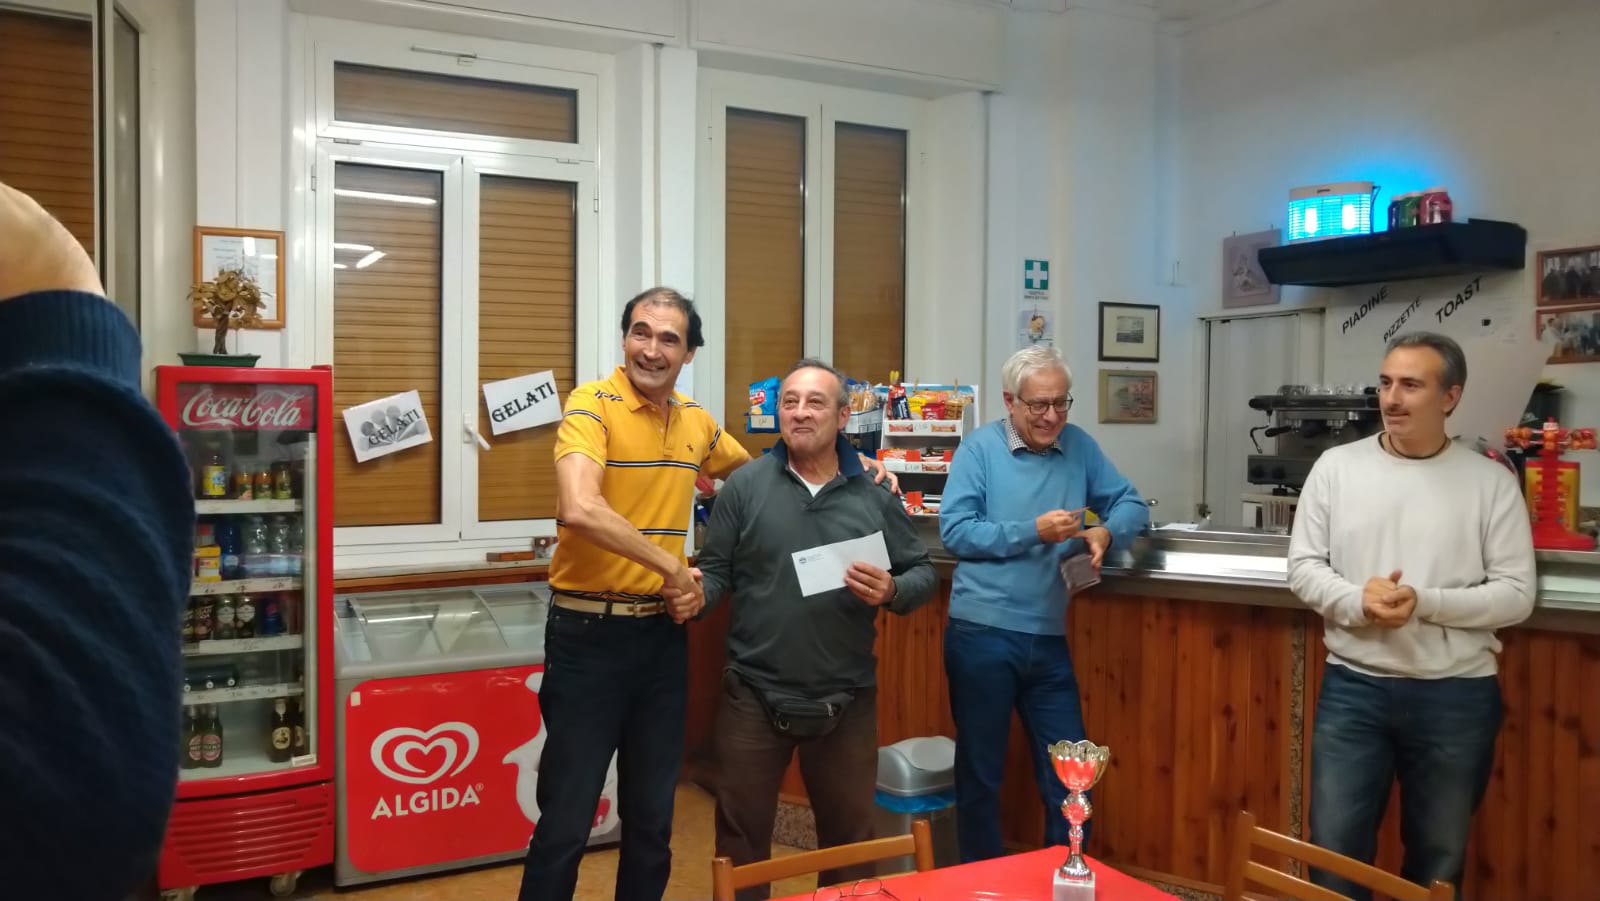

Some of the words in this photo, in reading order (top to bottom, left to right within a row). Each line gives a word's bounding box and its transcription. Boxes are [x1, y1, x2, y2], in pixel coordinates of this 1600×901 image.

[1342, 285, 1388, 334] PIADINE
[1383, 296, 1422, 344] PIZZETTE
[1435, 276, 1482, 324] TOAST
[182, 388, 304, 426] Coca-Cola
[491, 381, 555, 424] GELATI
[368, 409, 421, 446] GELATI
[371, 785, 480, 820] ALGIDA
